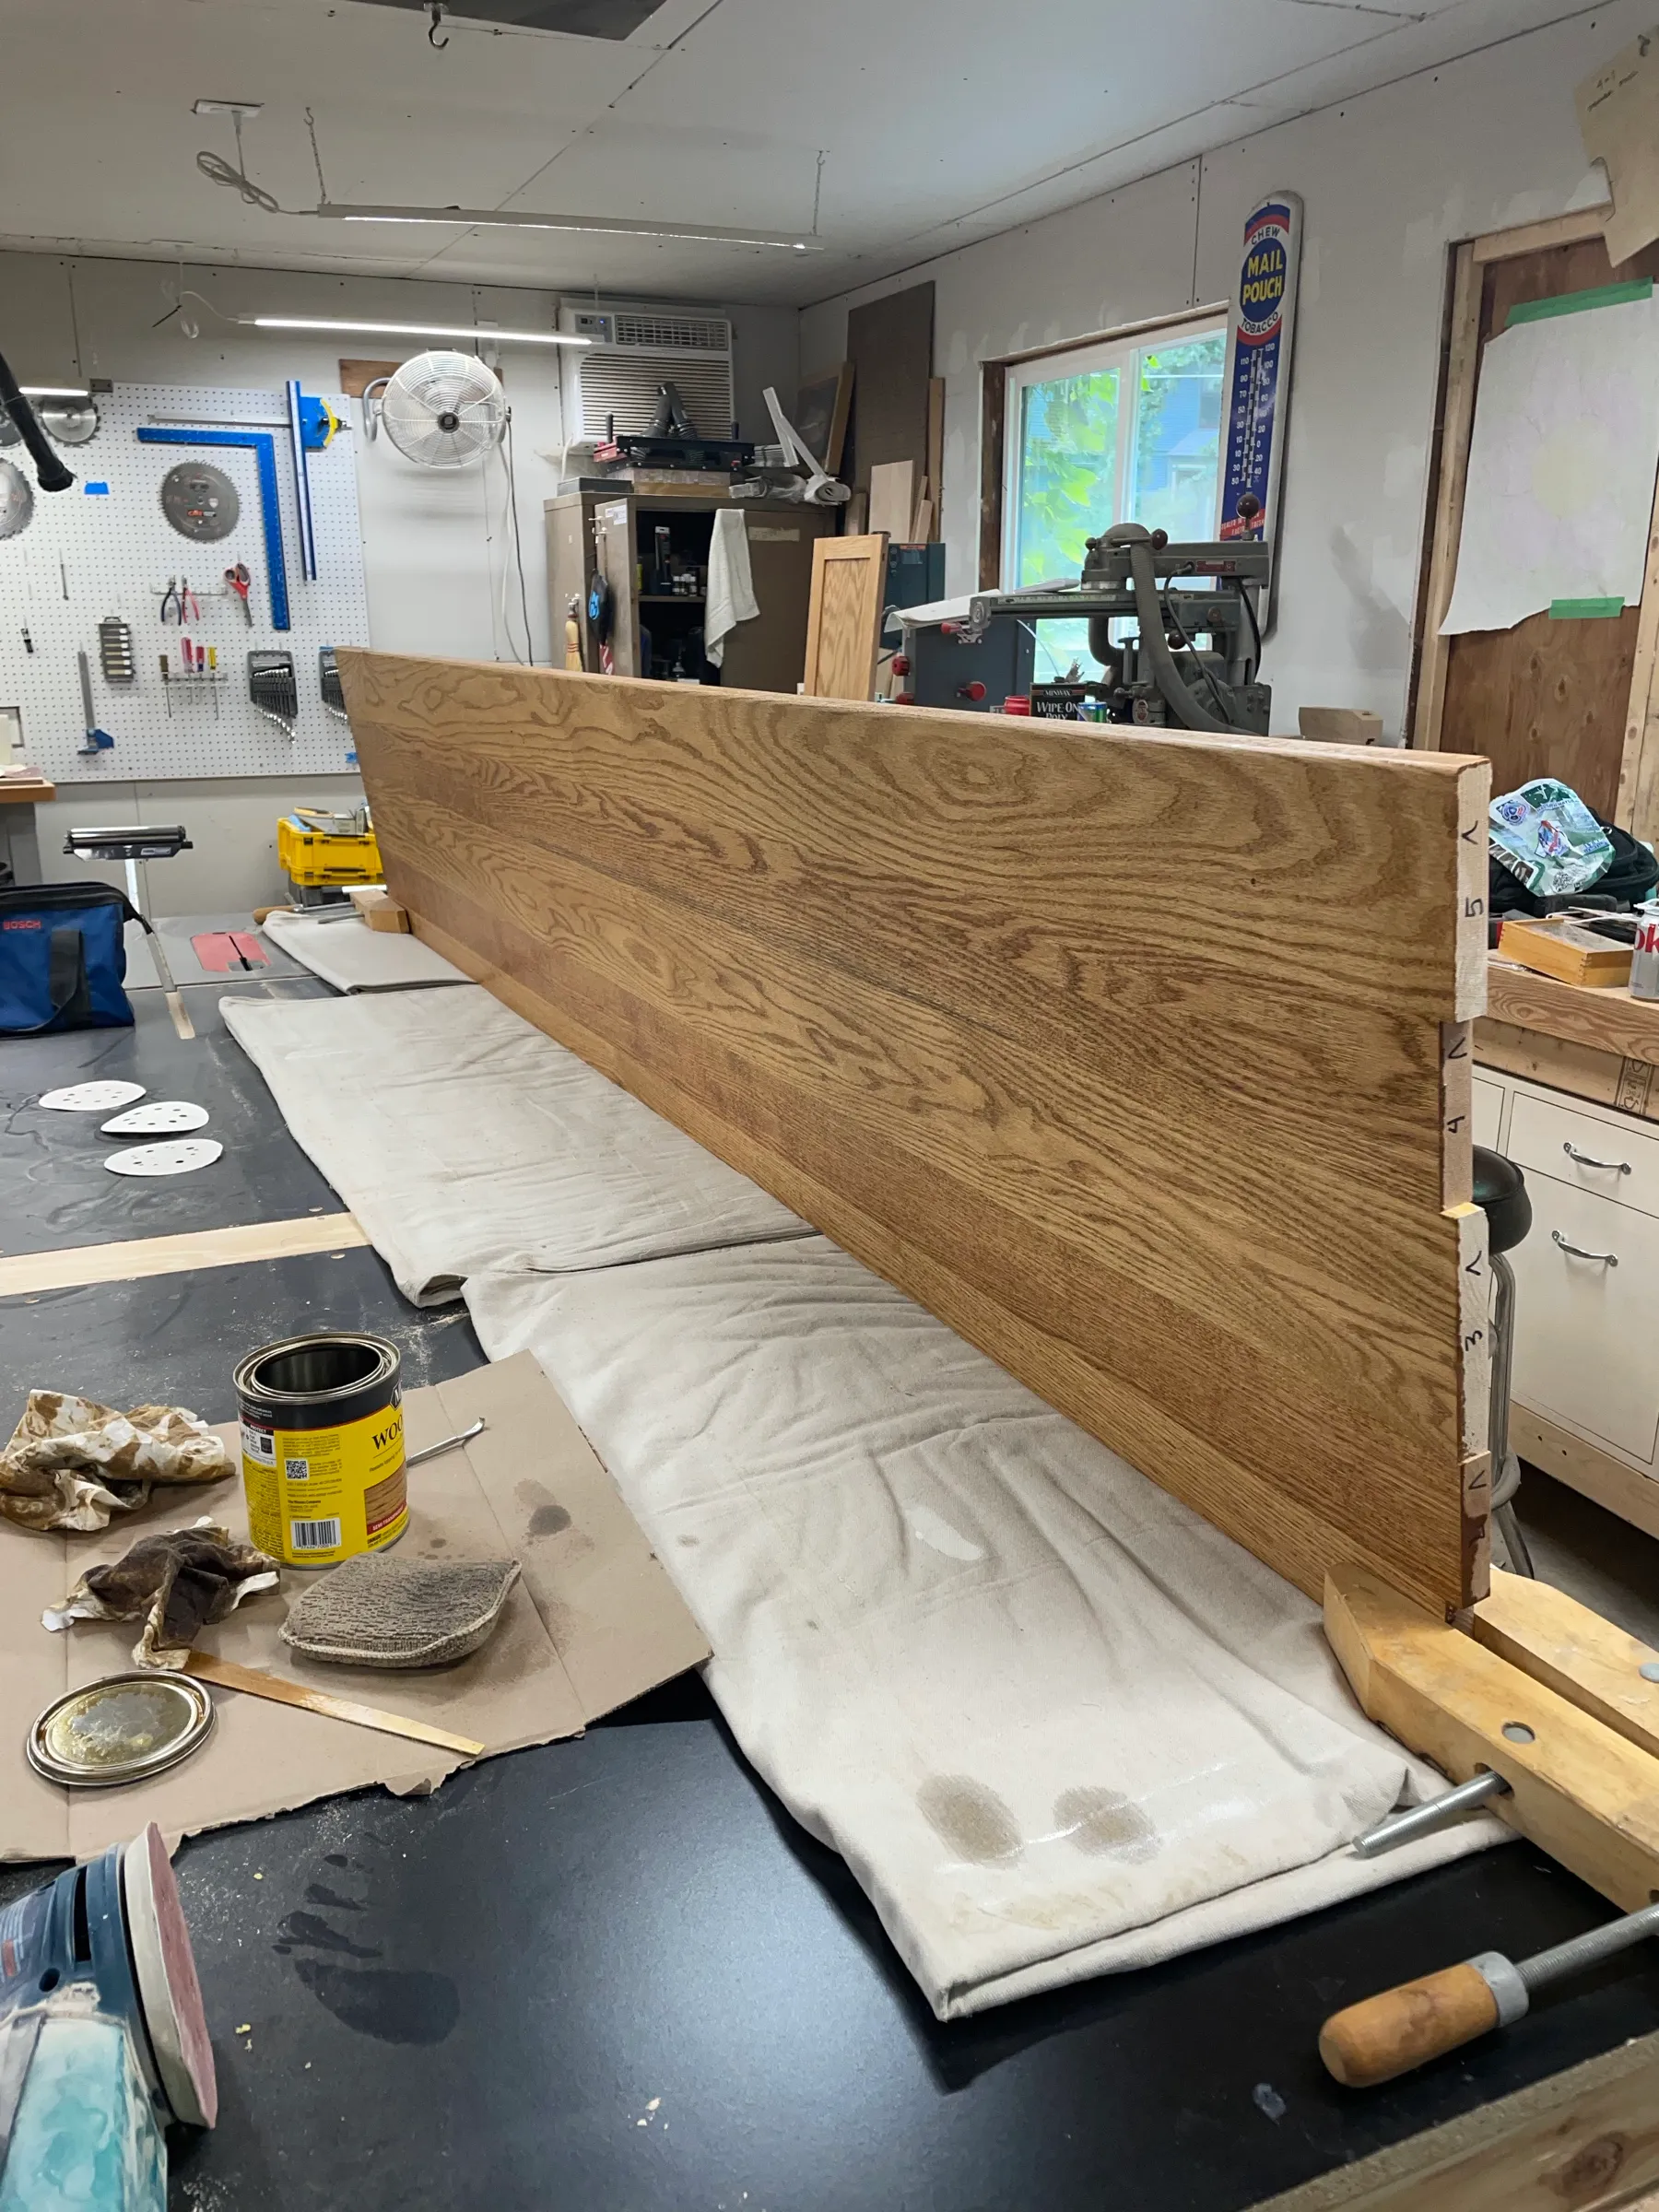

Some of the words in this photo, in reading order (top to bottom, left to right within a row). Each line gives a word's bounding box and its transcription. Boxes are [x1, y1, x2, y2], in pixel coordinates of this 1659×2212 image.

[1252, 226, 1280, 245] CHEW
[1247, 249, 1284, 278] MAIL
[1241, 275, 1283, 305] POUCH
[1241, 312, 1278, 334] TOBACCO
[1239, 390, 1247, 398] 70
[1257, 425, 1265, 433] 20
[1236, 435, 1243, 443] 10
[1256, 440, 1261, 448] 0
[1255, 453, 1263, 462] 20
[1232, 464, 1241, 472] 30
[1253, 466, 1262, 475] 40
[1465, 897, 1484, 918] 5
[3, 920, 41, 930] BOSCH
